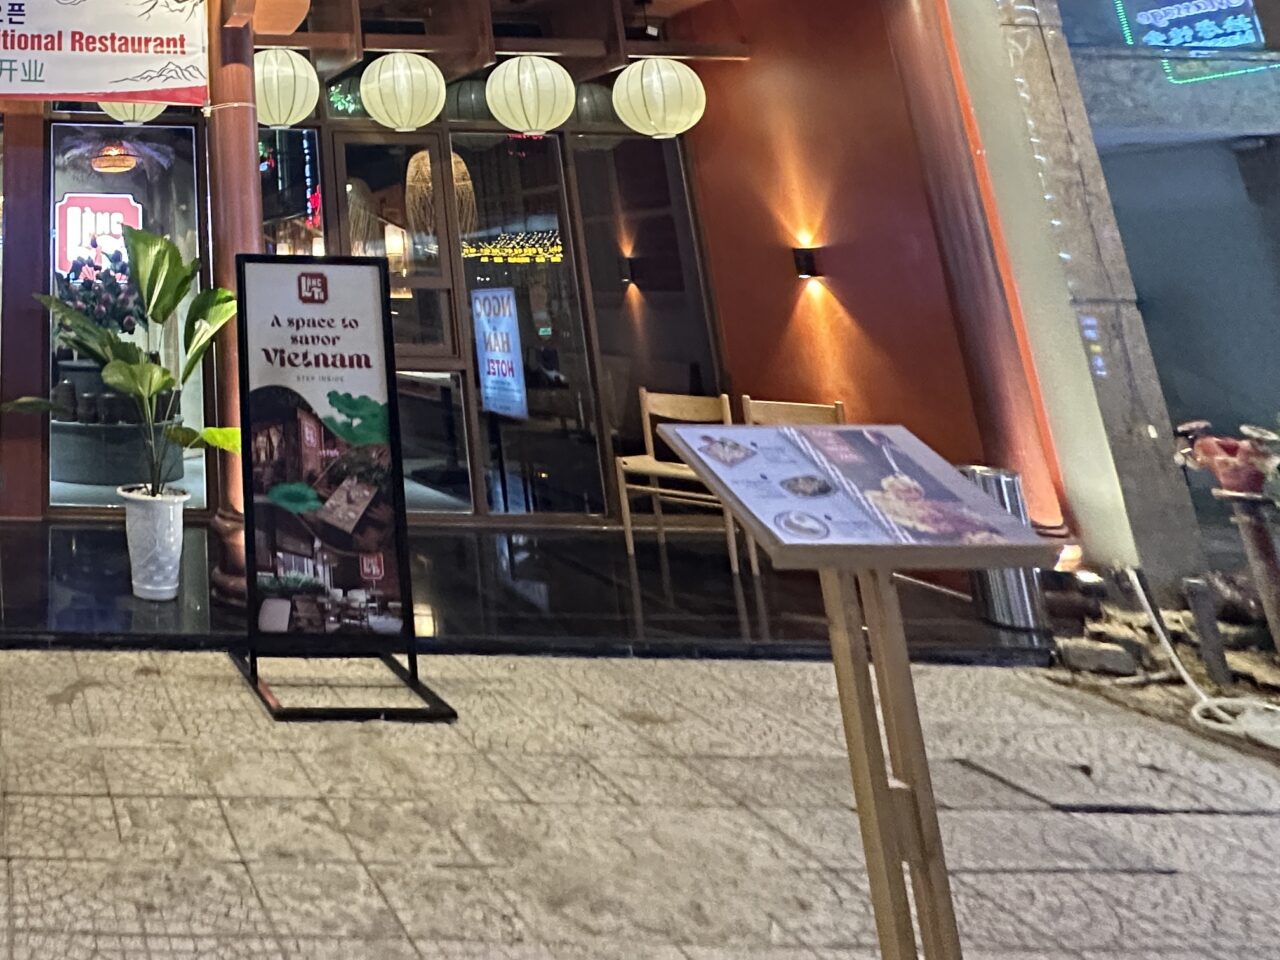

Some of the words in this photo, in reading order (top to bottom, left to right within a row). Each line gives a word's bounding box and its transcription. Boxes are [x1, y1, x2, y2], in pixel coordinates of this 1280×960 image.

[70, 30, 186, 55] Restaurant
[271, 315, 282, 329] A
[287, 316, 336, 331] space
[341, 317, 360, 330] to
[290, 334, 341, 347] savor
[261, 348, 373, 370] Vietnam
